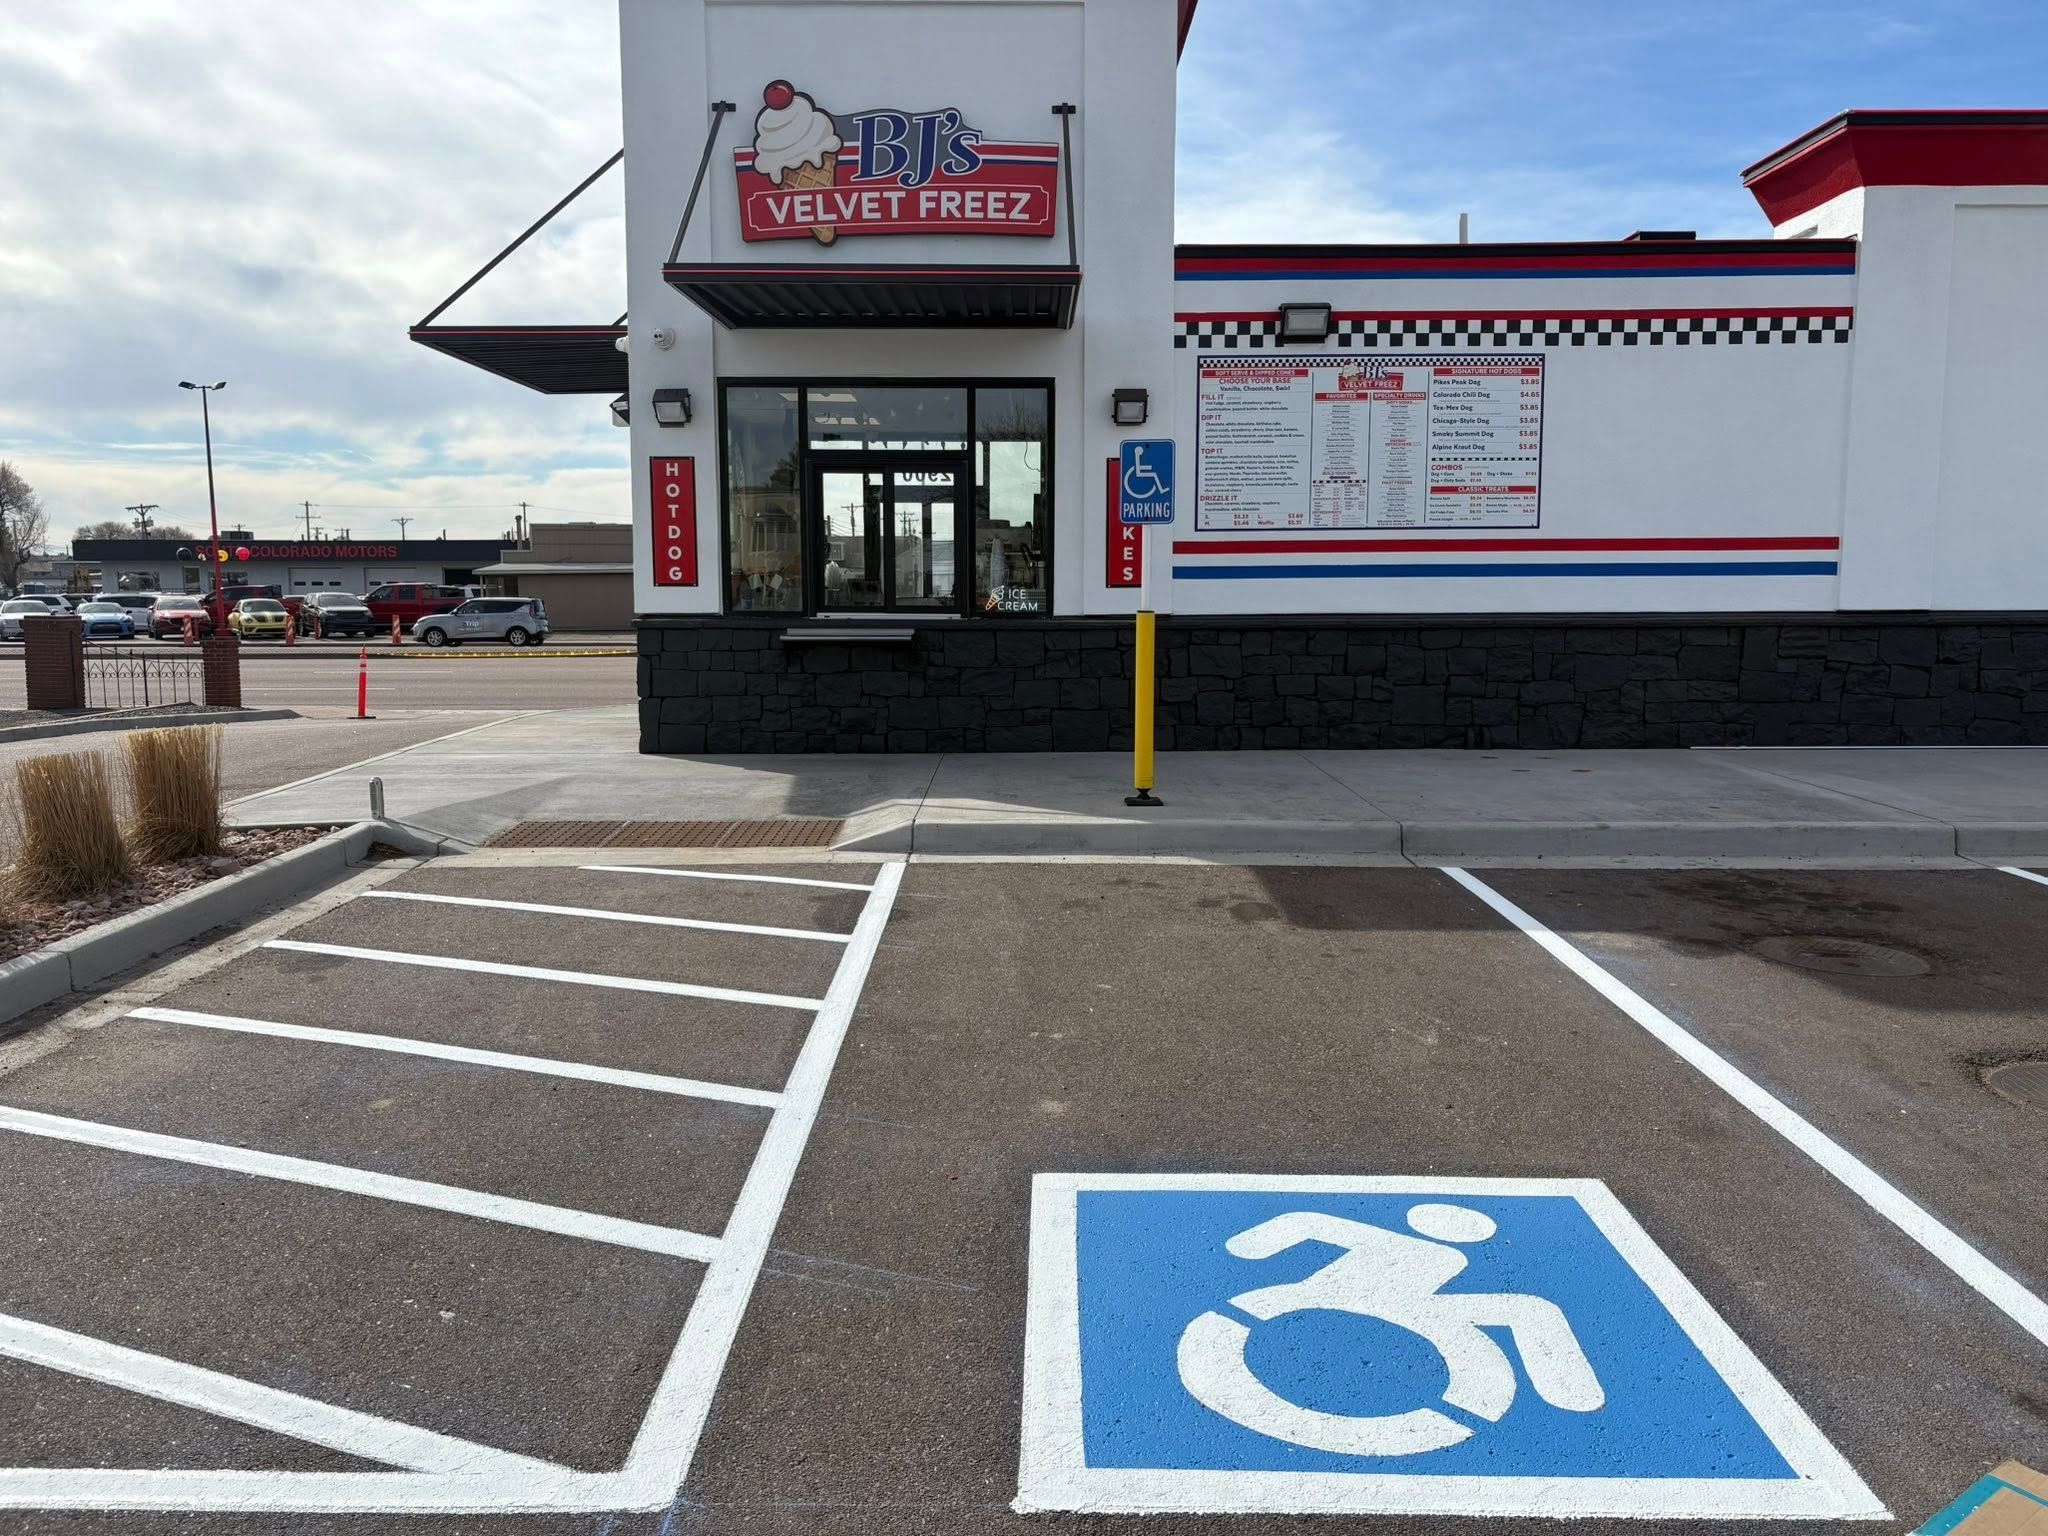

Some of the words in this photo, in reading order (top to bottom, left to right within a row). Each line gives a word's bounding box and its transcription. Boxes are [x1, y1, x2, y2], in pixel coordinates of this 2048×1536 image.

[850, 109, 983, 188] BJ's
[766, 191, 906, 224] VELVET
[919, 191, 1031, 220] FREEZ
[1123, 502, 1170, 518] PARKING
[250, 546, 334, 558] COLORADO
[336, 546, 397, 558] MOTORS
[1123, 527, 1135, 581] KES
[1009, 589, 1026, 599] ICE
[998, 601, 1038, 611] CREAM
